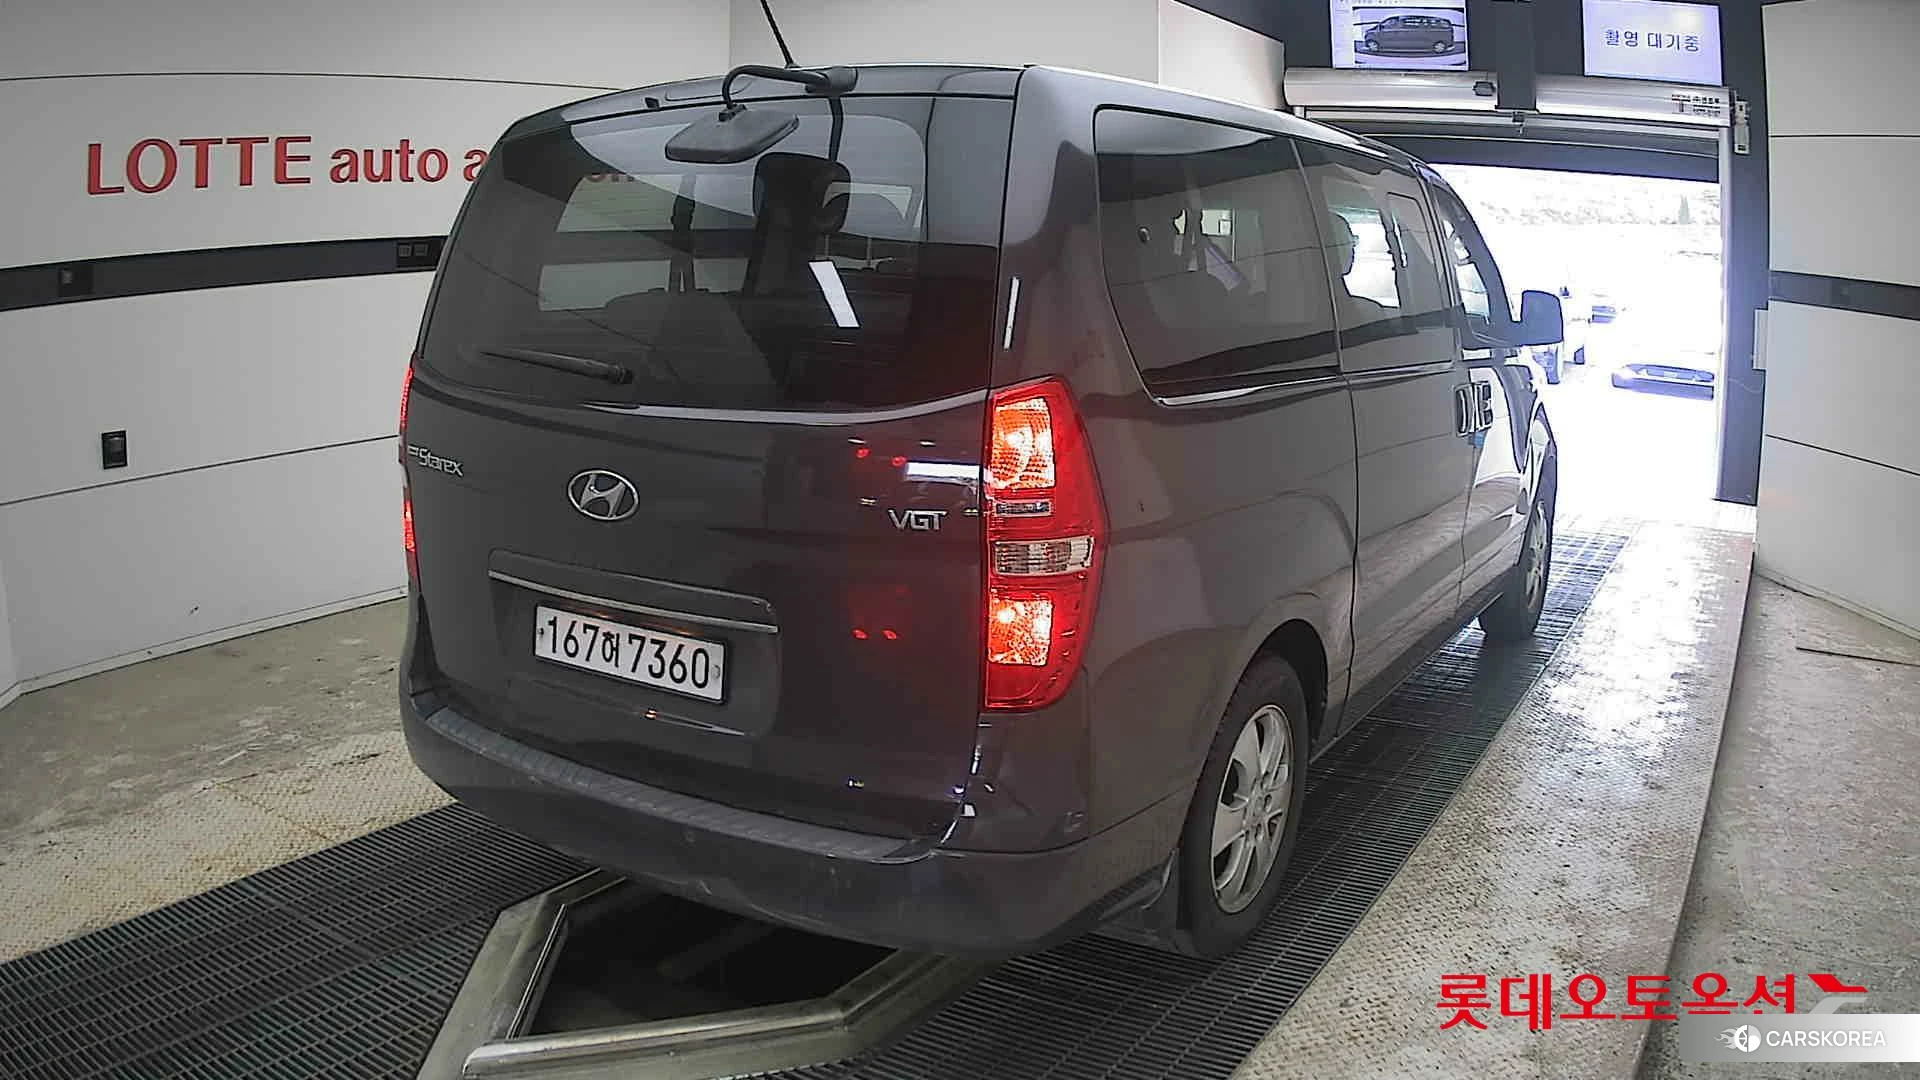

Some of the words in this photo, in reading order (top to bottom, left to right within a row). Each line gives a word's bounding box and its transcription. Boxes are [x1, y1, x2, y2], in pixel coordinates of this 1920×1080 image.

[1647, 33, 1700, 52] 대기중
[87, 135, 312, 196] LOTTE
[329, 138, 449, 184] auto
[888, 508, 949, 531] VGT
